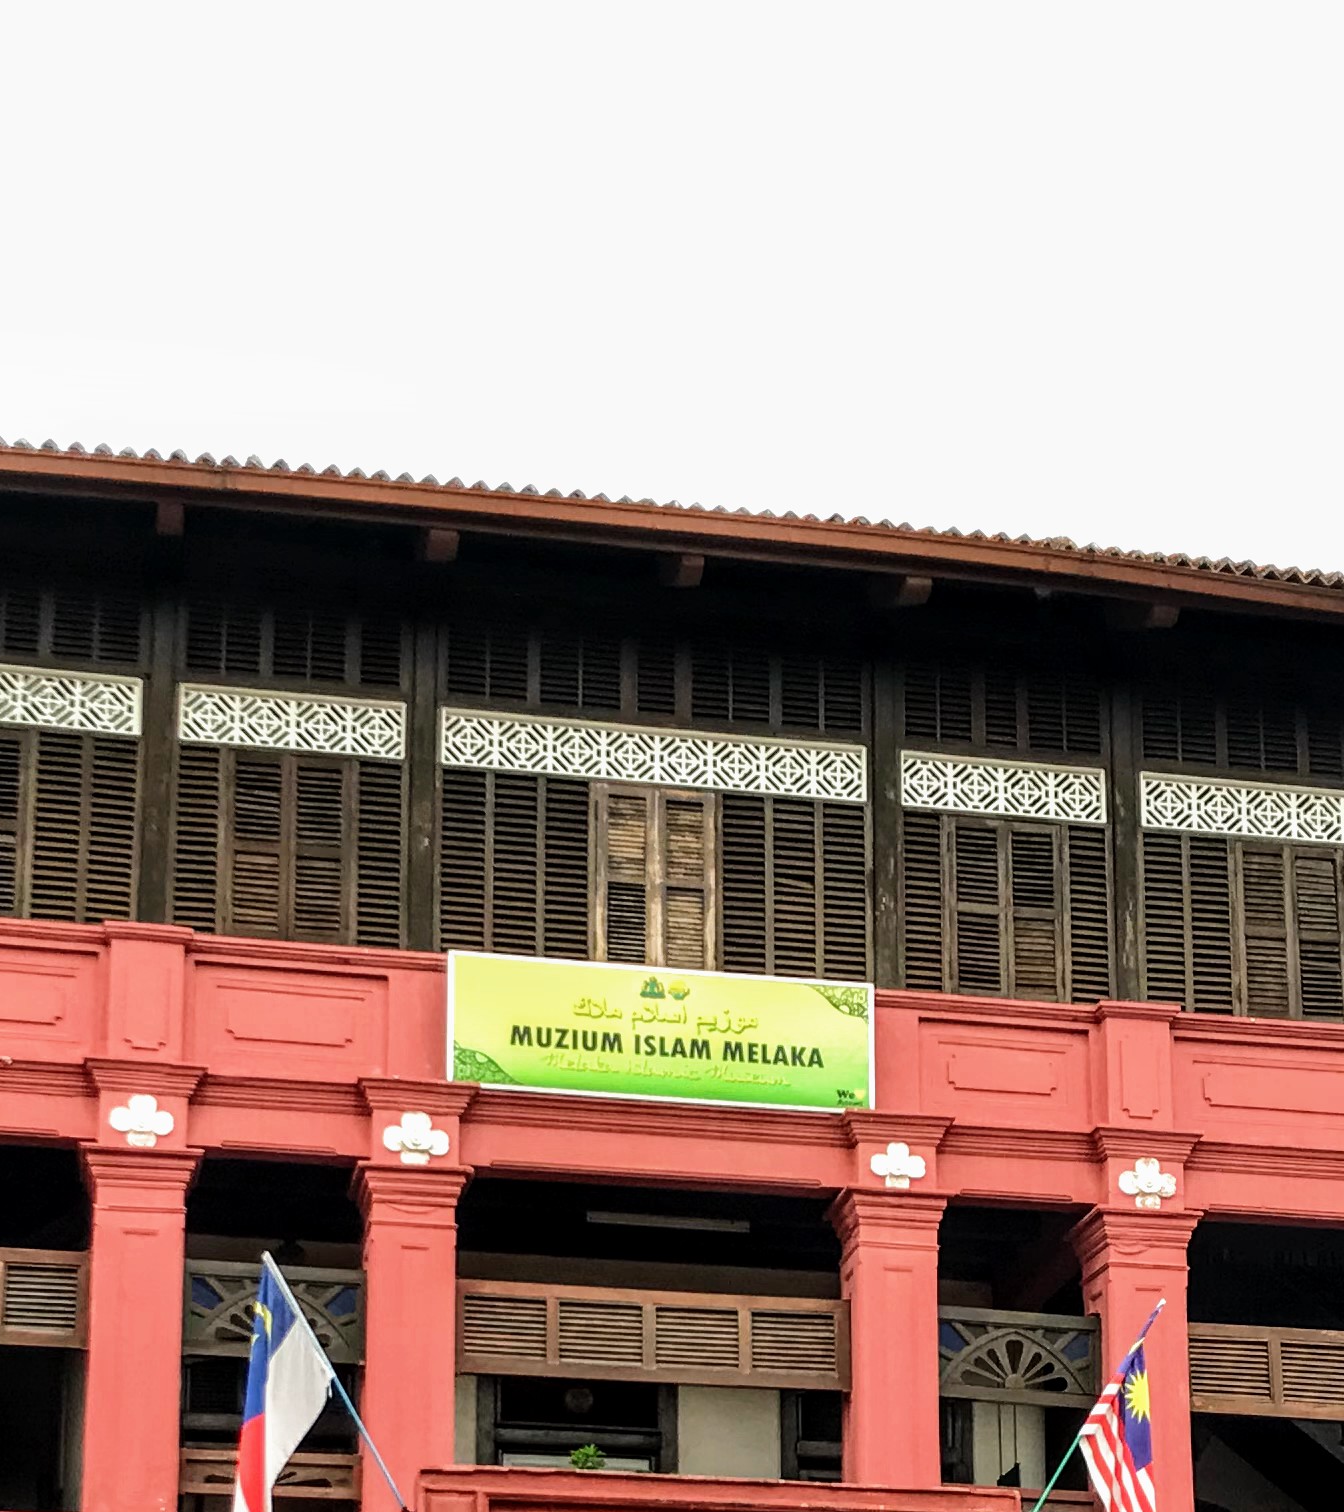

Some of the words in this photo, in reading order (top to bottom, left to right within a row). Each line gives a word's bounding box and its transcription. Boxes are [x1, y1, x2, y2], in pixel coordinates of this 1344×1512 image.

[510, 1025, 624, 1053] MUZIUM
[634, 1034, 712, 1060] ISLAM
[722, 1041, 825, 1068] MELAKA
